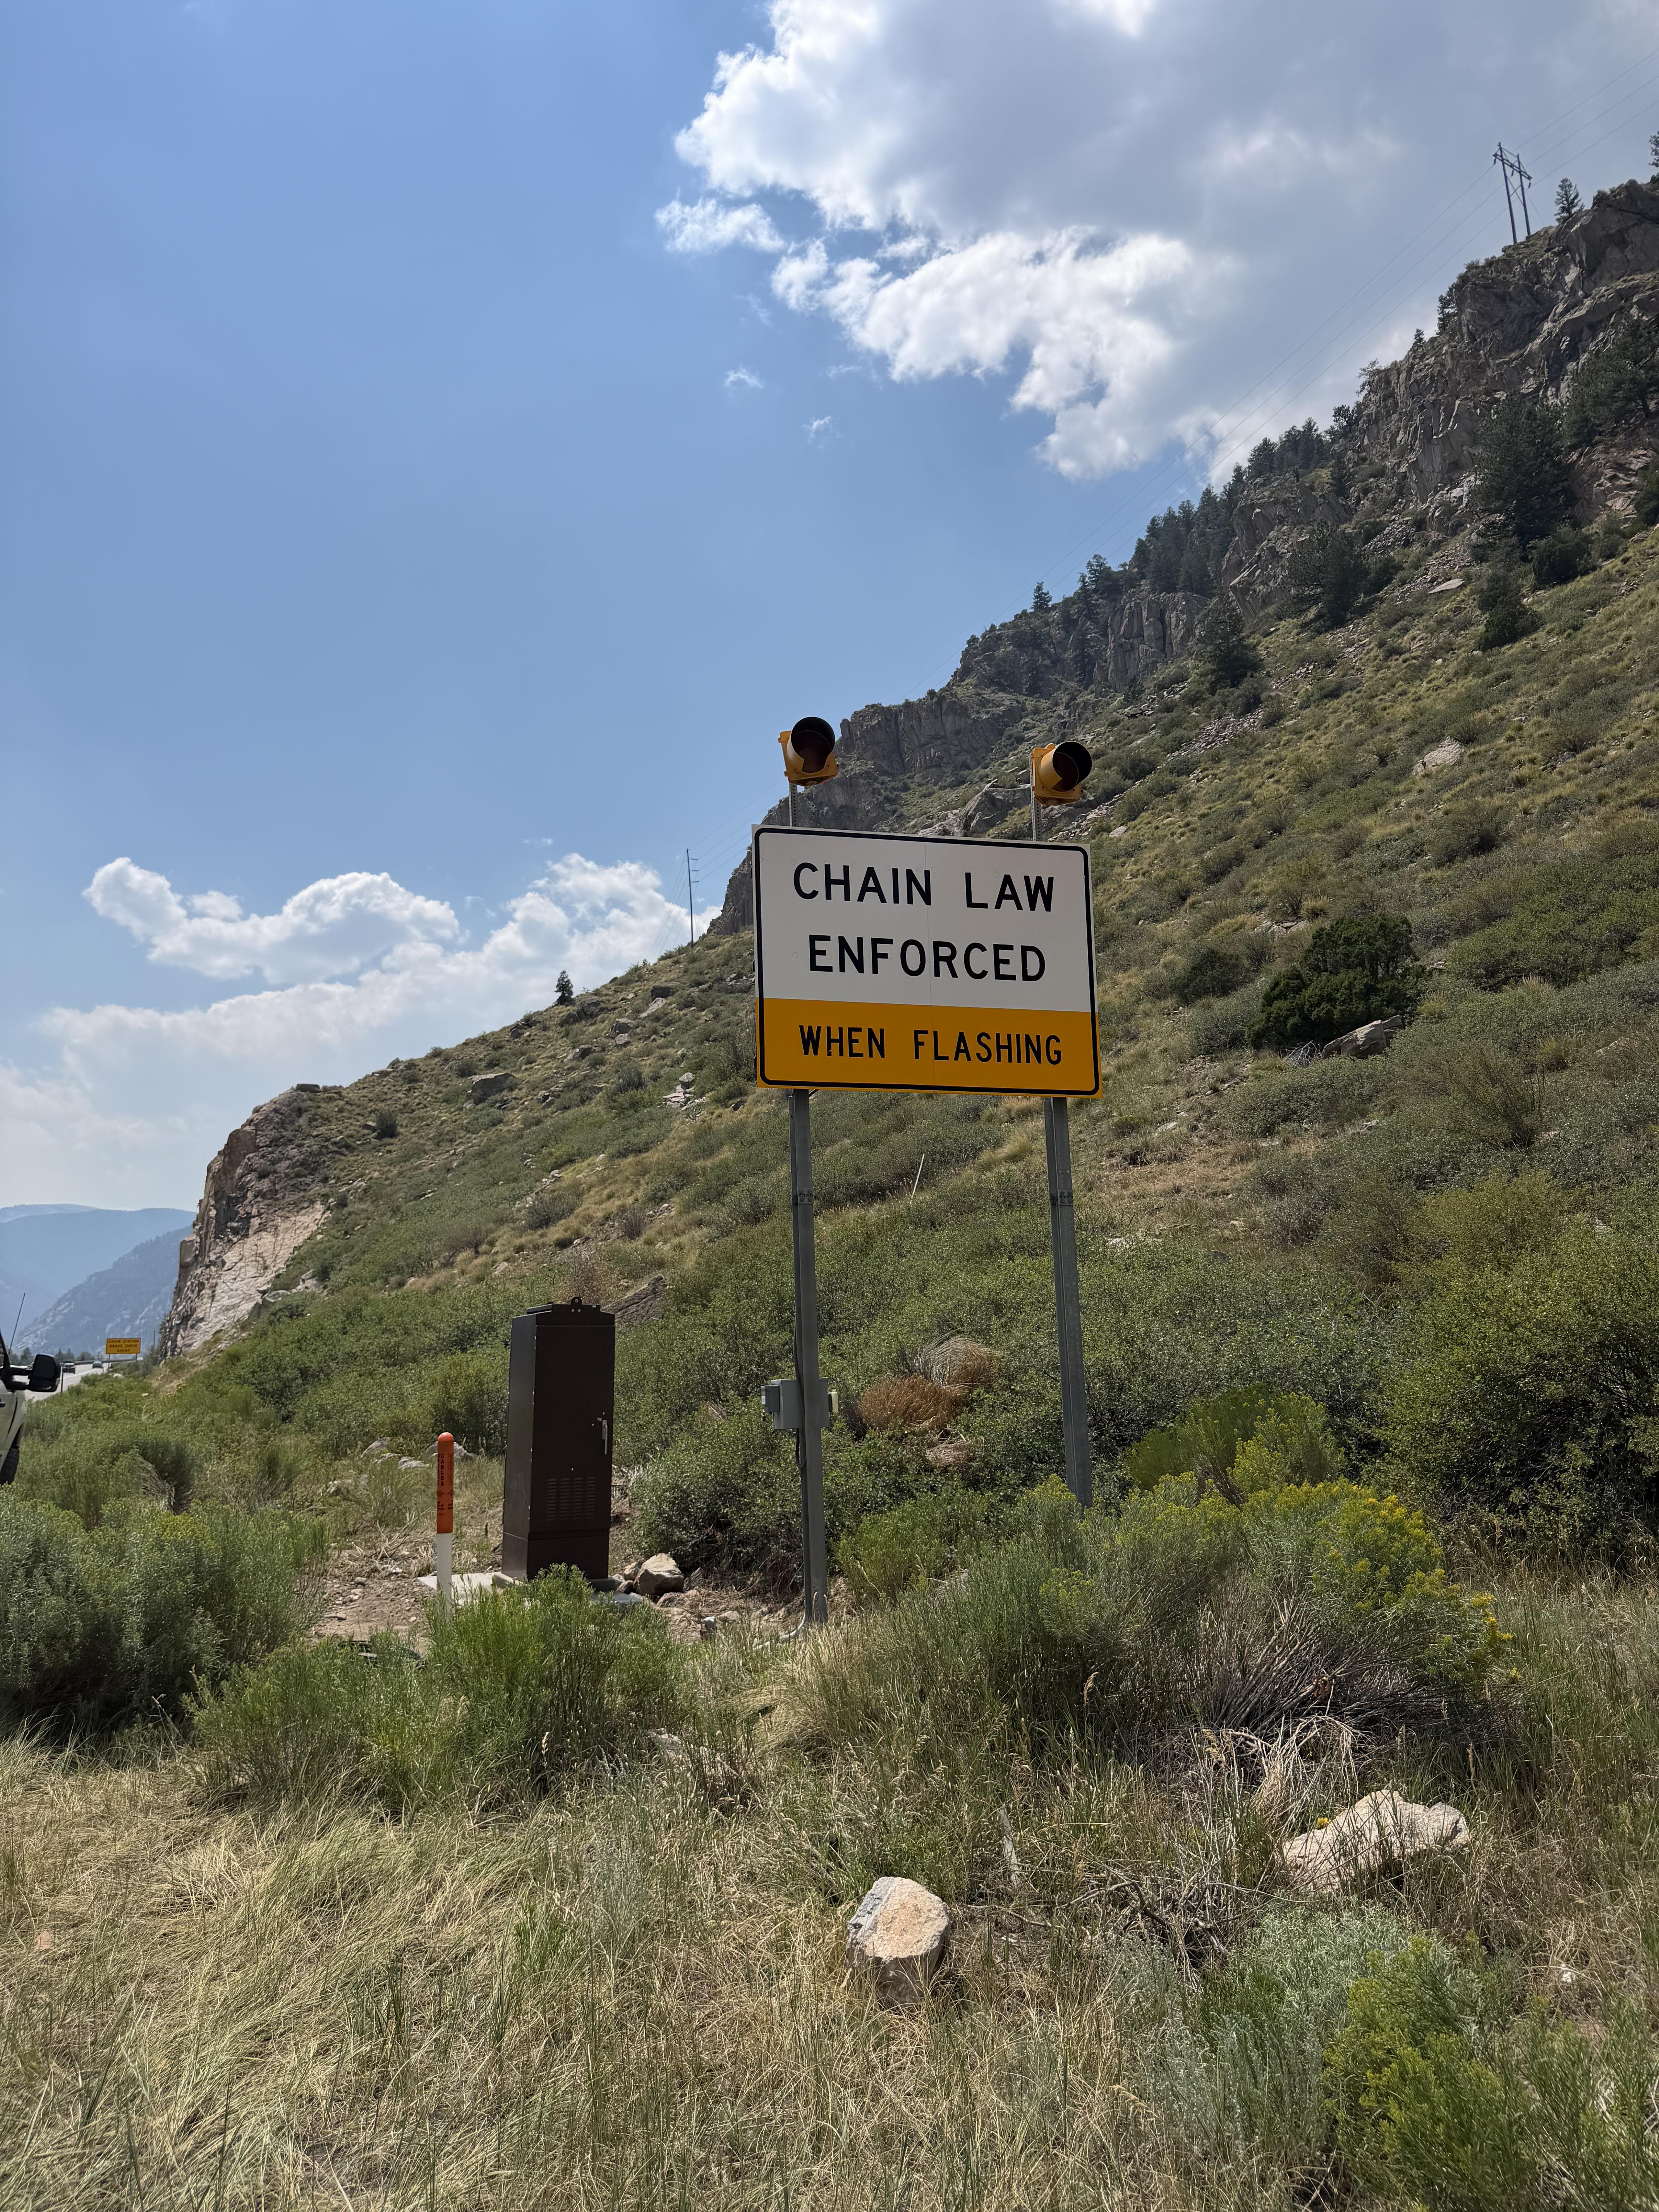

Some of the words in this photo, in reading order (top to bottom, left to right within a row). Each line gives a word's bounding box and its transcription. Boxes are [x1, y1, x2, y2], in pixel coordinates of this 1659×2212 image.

[794, 862, 931, 906] CHAIN
[965, 872, 1054, 912] LAW
[809, 934, 1045, 981] ENFORCED
[799, 1025, 885, 1058] WHEN
[914, 1030, 1061, 1065] FLASHING
